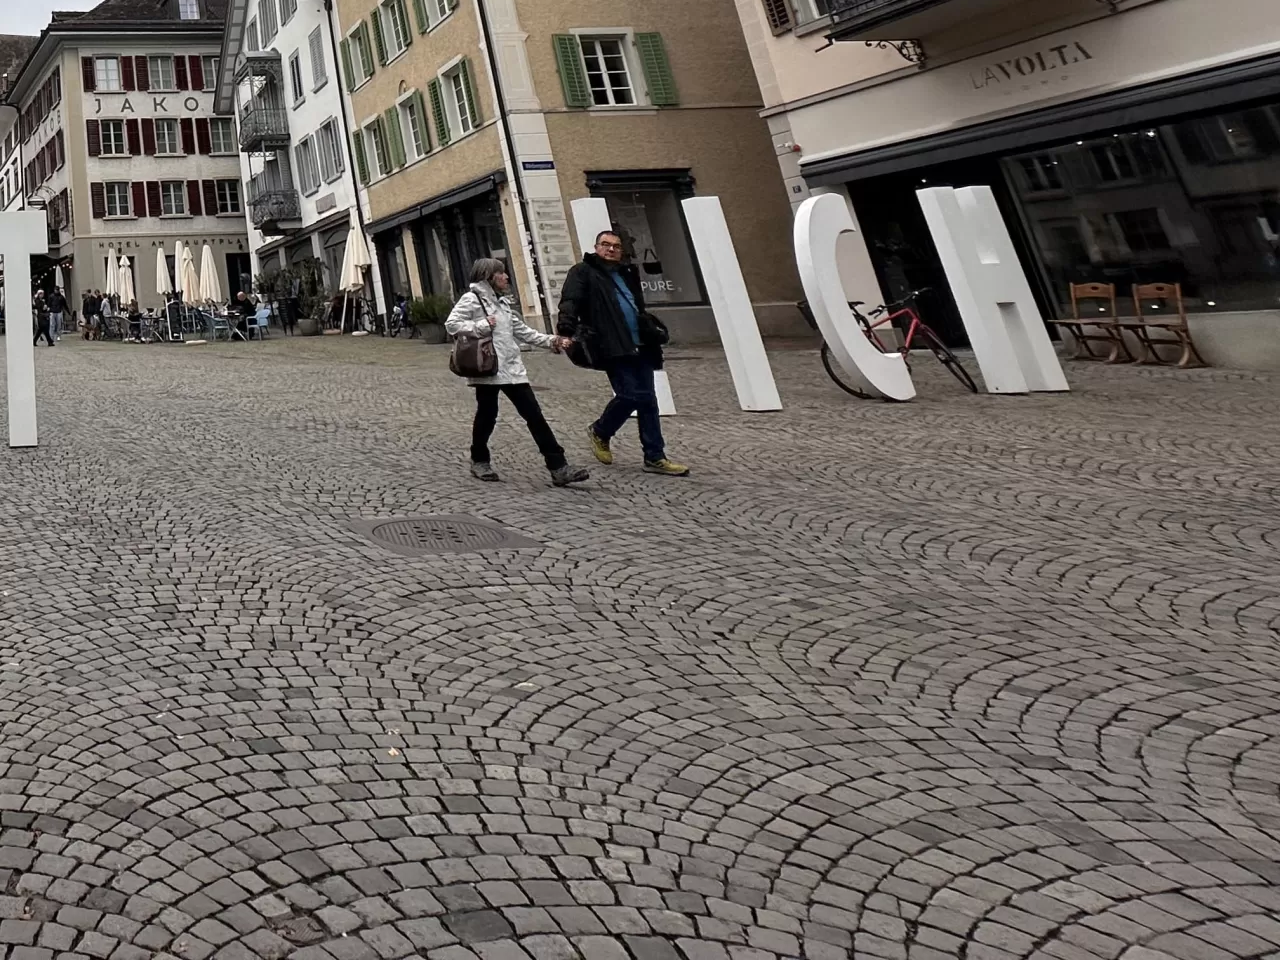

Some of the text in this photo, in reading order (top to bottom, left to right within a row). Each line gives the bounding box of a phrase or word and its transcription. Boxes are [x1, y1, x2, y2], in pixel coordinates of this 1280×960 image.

[95, 97, 199, 114] JAKO
[99, 241, 140, 249] HOTEL
[640, 280, 675, 292] PURE
